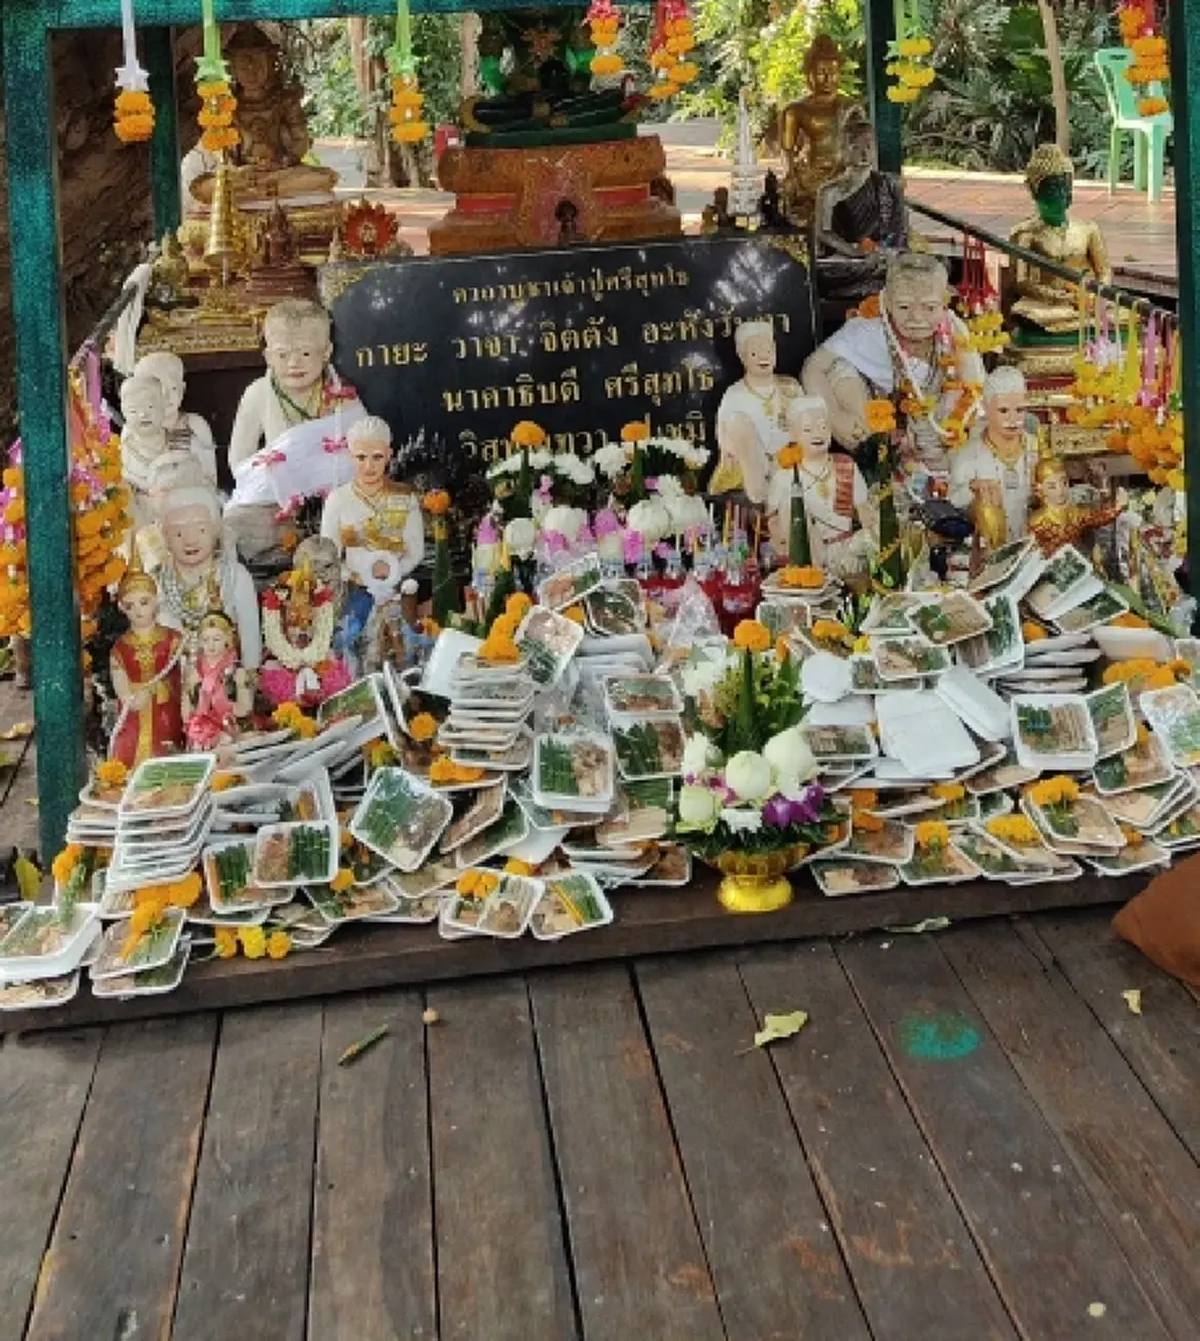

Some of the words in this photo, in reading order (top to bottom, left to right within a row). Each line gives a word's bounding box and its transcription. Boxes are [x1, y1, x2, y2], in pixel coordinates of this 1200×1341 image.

[355, 341, 429, 368] กายะ
[451, 332, 521, 359] วาจา
[539, 316, 619, 352] จิตตัง
[442, 365, 581, 412] นาคาธิบดี
[604, 356, 714, 407] ศรีสุทโธ
